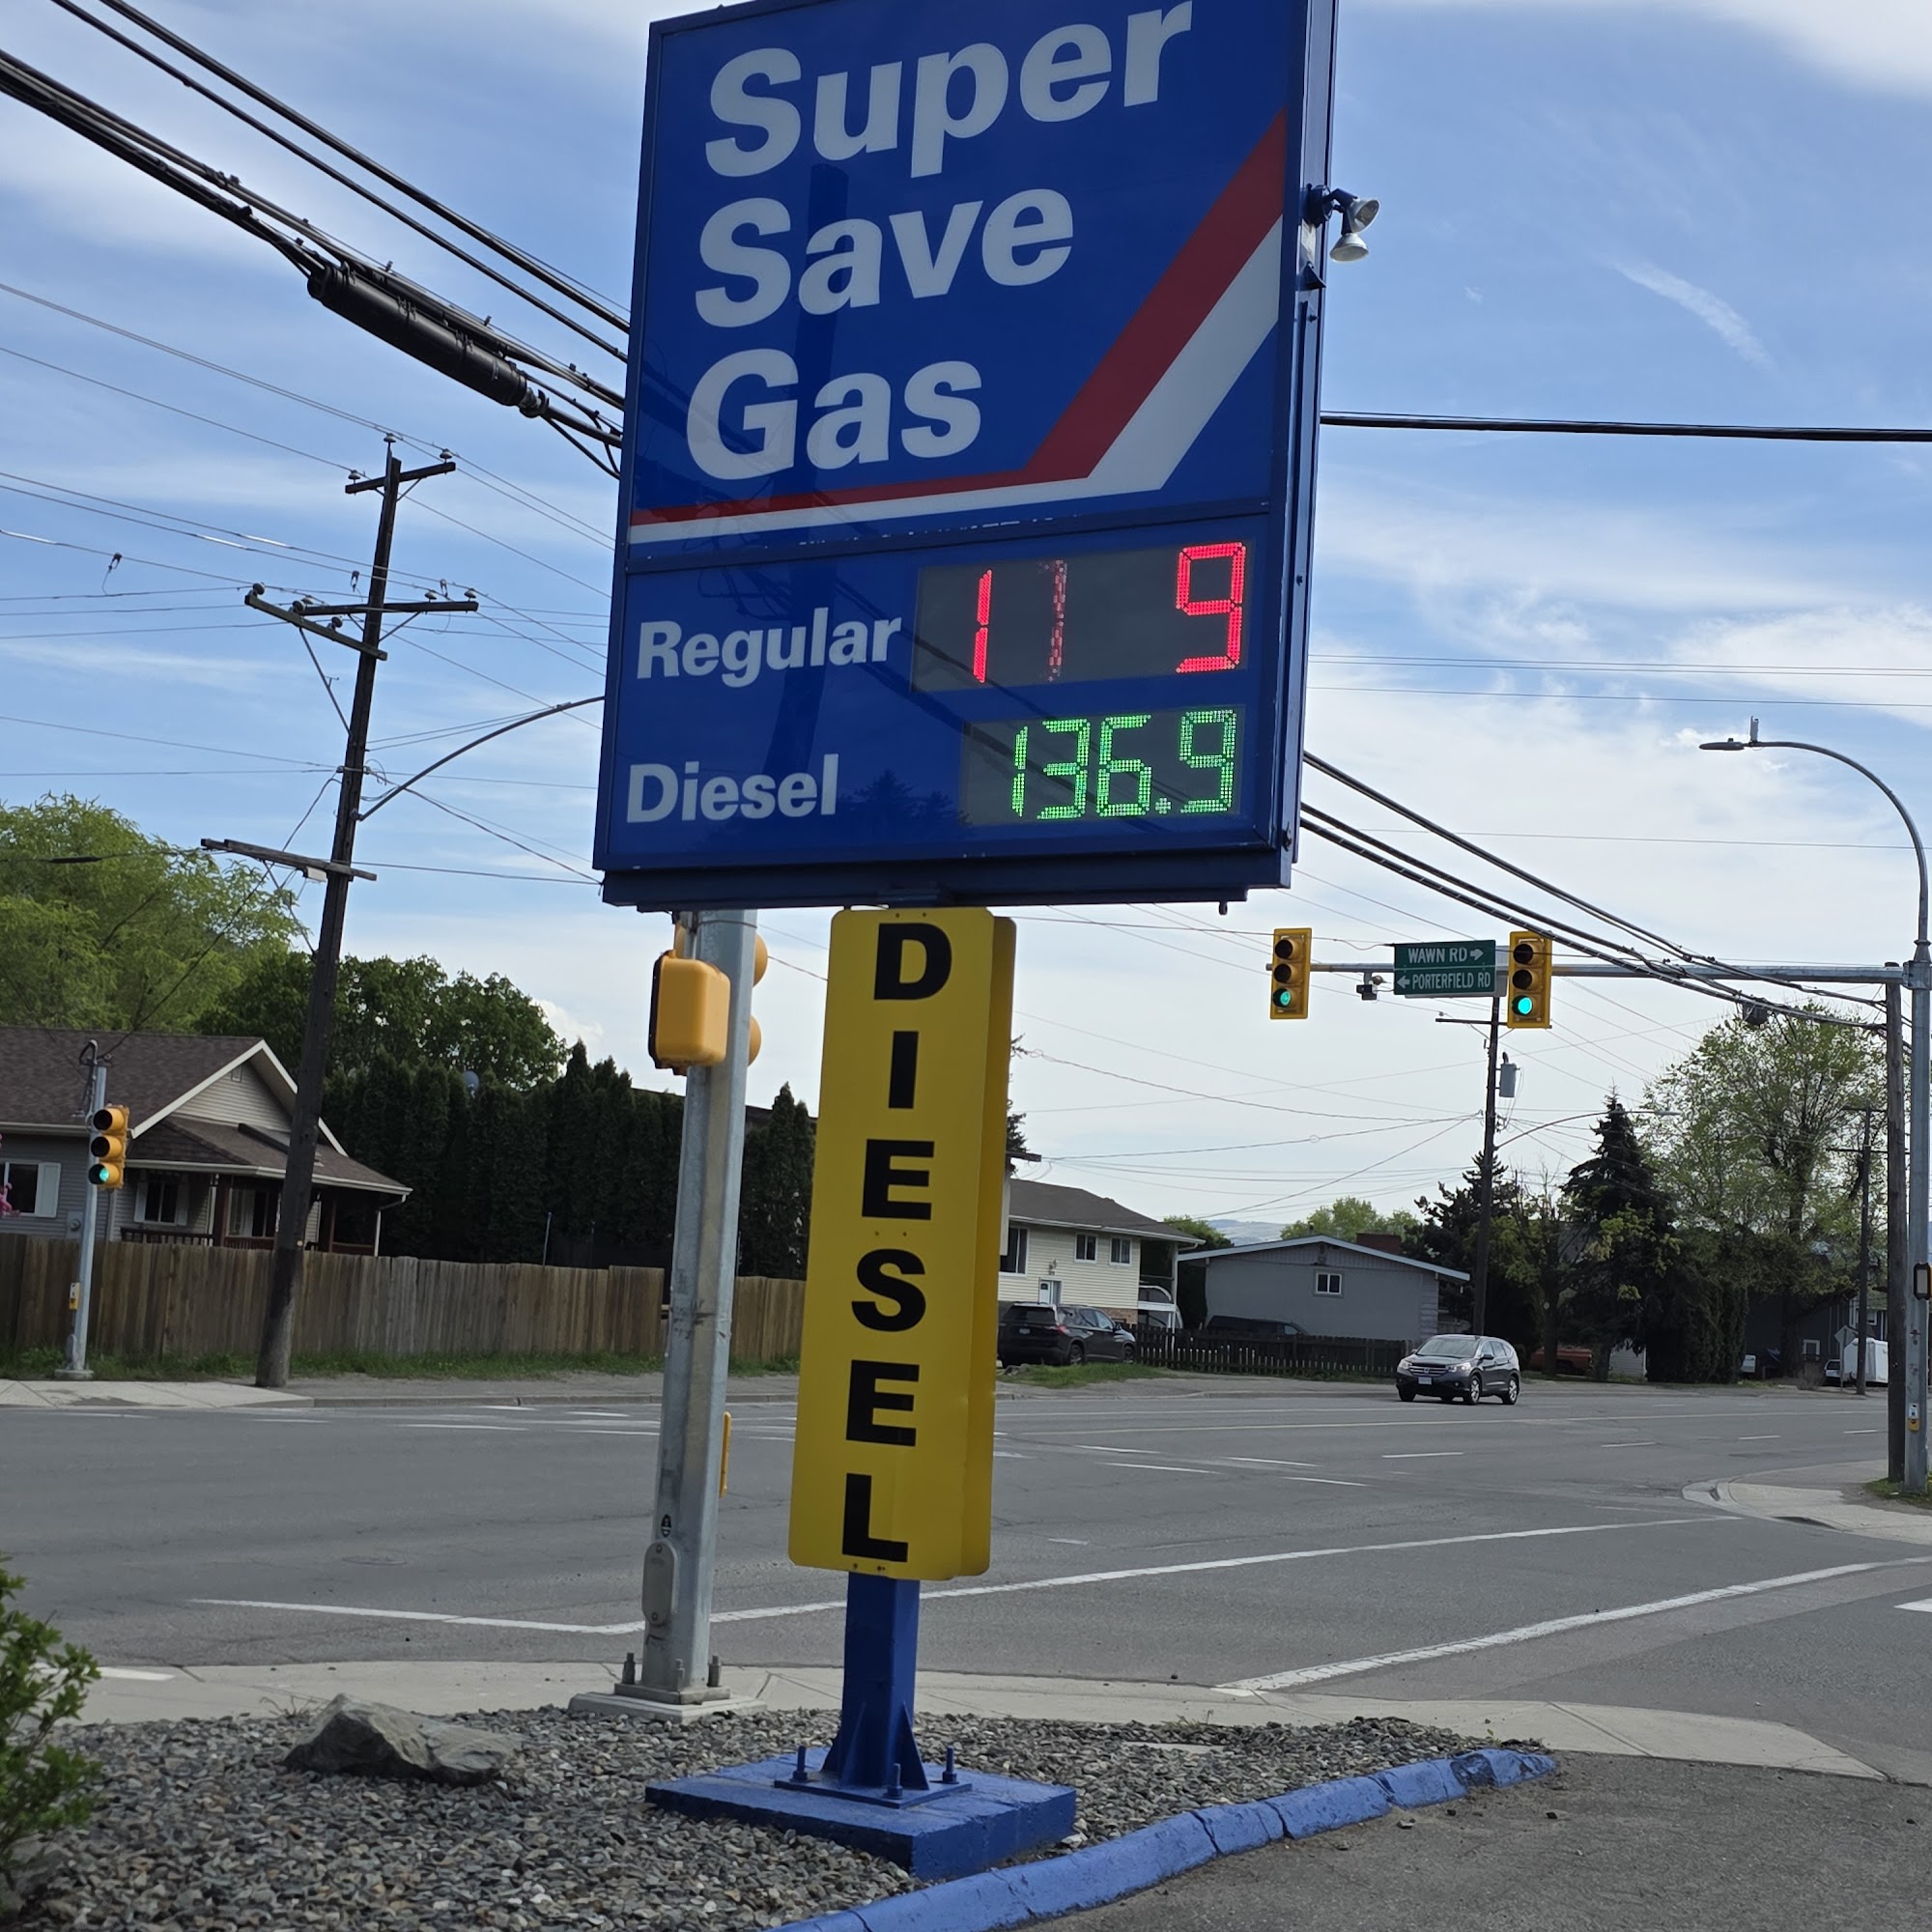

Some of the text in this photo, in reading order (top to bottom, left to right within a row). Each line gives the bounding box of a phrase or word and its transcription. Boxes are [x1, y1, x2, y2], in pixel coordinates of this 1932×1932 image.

[705, 1, 1193, 178] Super
[696, 188, 1074, 328] Save
[686, 348, 982, 481] Gas
[637, 606, 901, 687] Regular
[626, 709, 1237, 823] Diesel 136.9
[1407, 947, 1468, 964] WAWN RD
[1411, 971, 1492, 990] PORTERFIELD RD
[841, 923, 952, 1563] DIESEL
